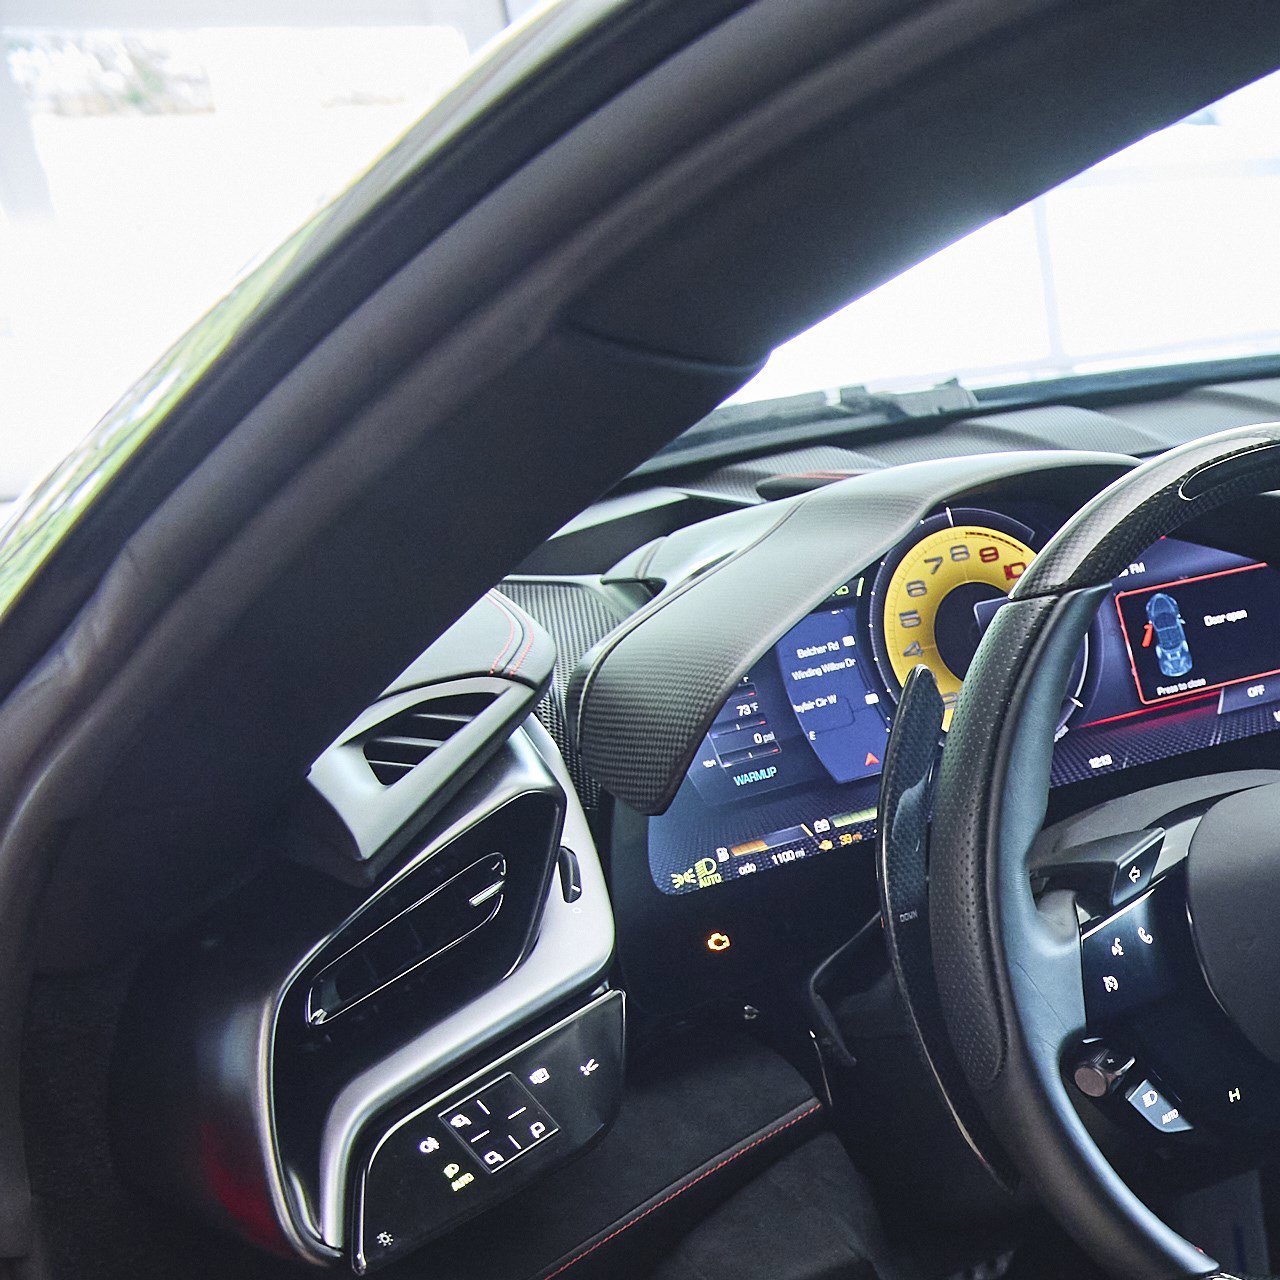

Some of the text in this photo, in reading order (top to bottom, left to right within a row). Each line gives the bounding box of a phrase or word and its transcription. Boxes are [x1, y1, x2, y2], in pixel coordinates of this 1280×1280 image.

[950, 544, 970, 562] 8
[979, 546, 999, 563] 9
[924, 556, 944, 575] 7
[906, 580, 927, 598] 6
[899, 610, 922, 629] 5
[903, 641, 924, 658] 4
[826, 694, 837, 704] W
[1247, 684, 1265, 698] OFF
[733, 766, 777, 786] WARMUP
[738, 862, 756, 876] odo
[698, 872, 722, 888] AUTO
[1228, 1087, 1240, 1103] H
